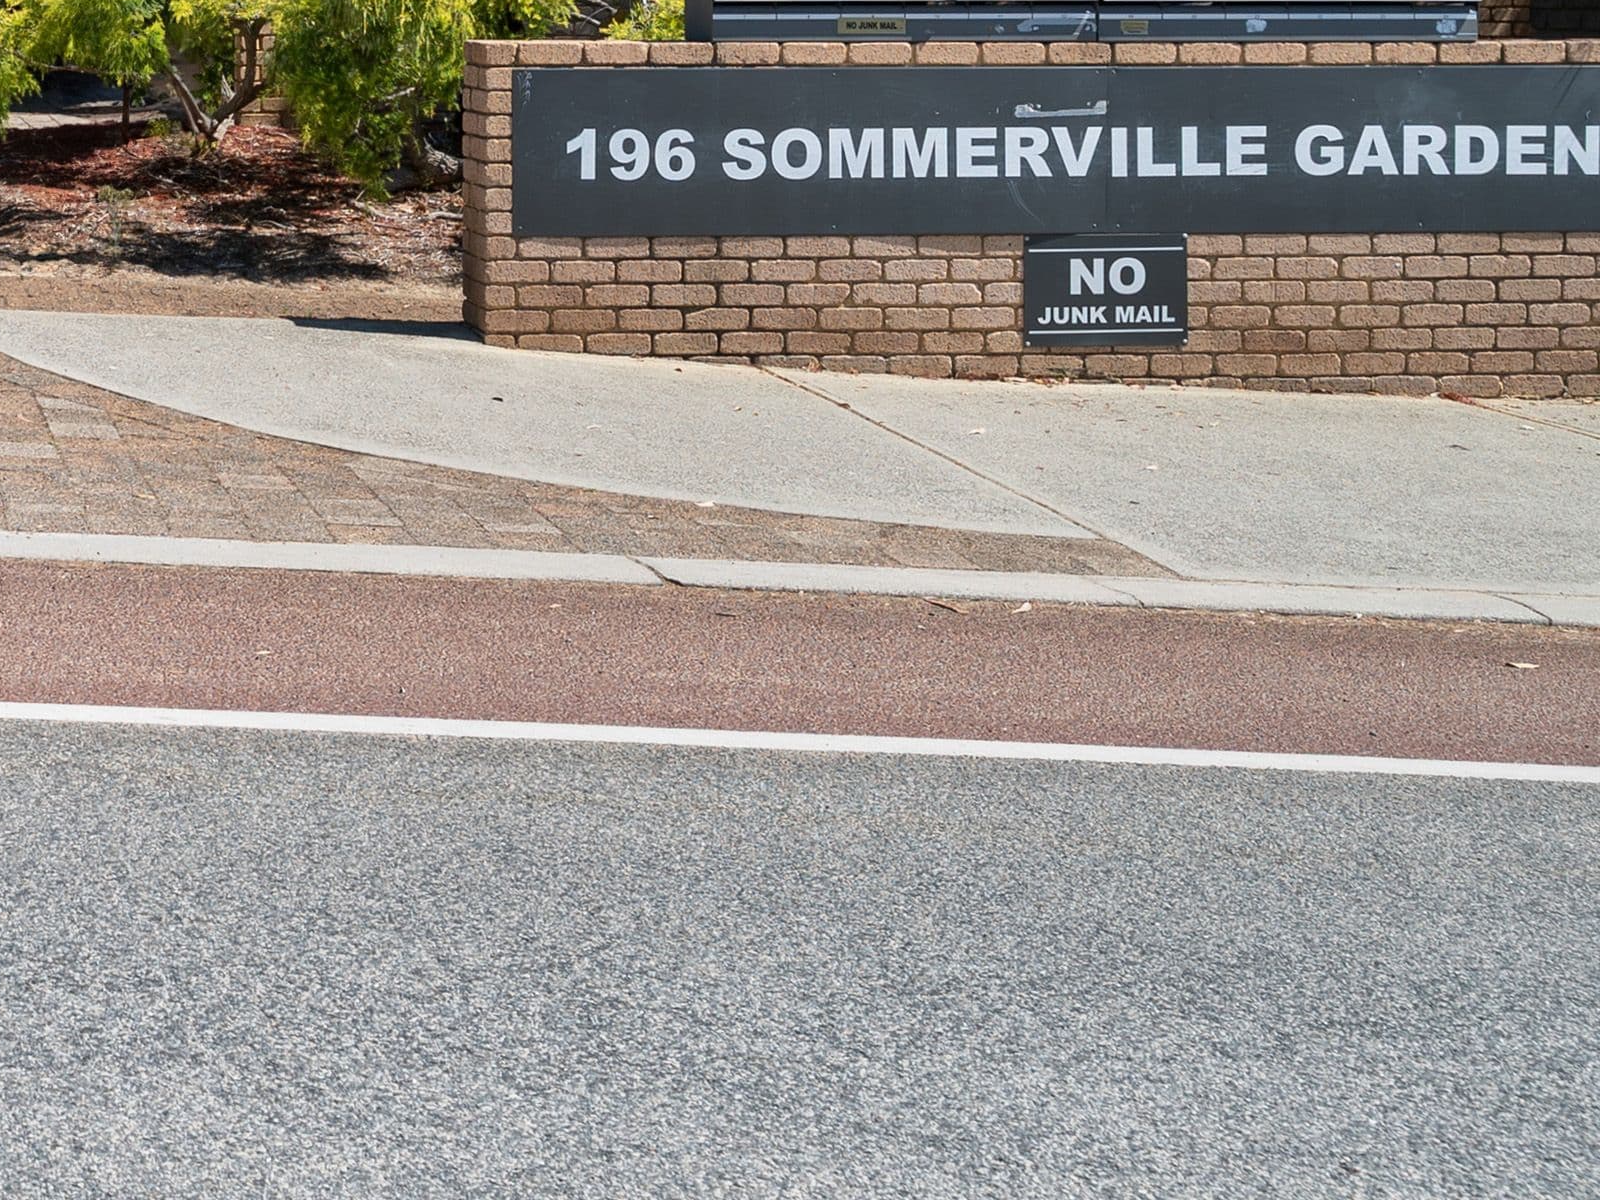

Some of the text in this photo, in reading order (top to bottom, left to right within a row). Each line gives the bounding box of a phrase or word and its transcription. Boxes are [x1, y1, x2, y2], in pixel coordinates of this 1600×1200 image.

[846, 21, 898, 30] NO JUNK MAIL
[566, 124, 1600, 181] 196 SOMMERVILLE GARDEN
[1069, 257, 1147, 295] NO
[1037, 305, 1176, 325] JUNK MAIL
